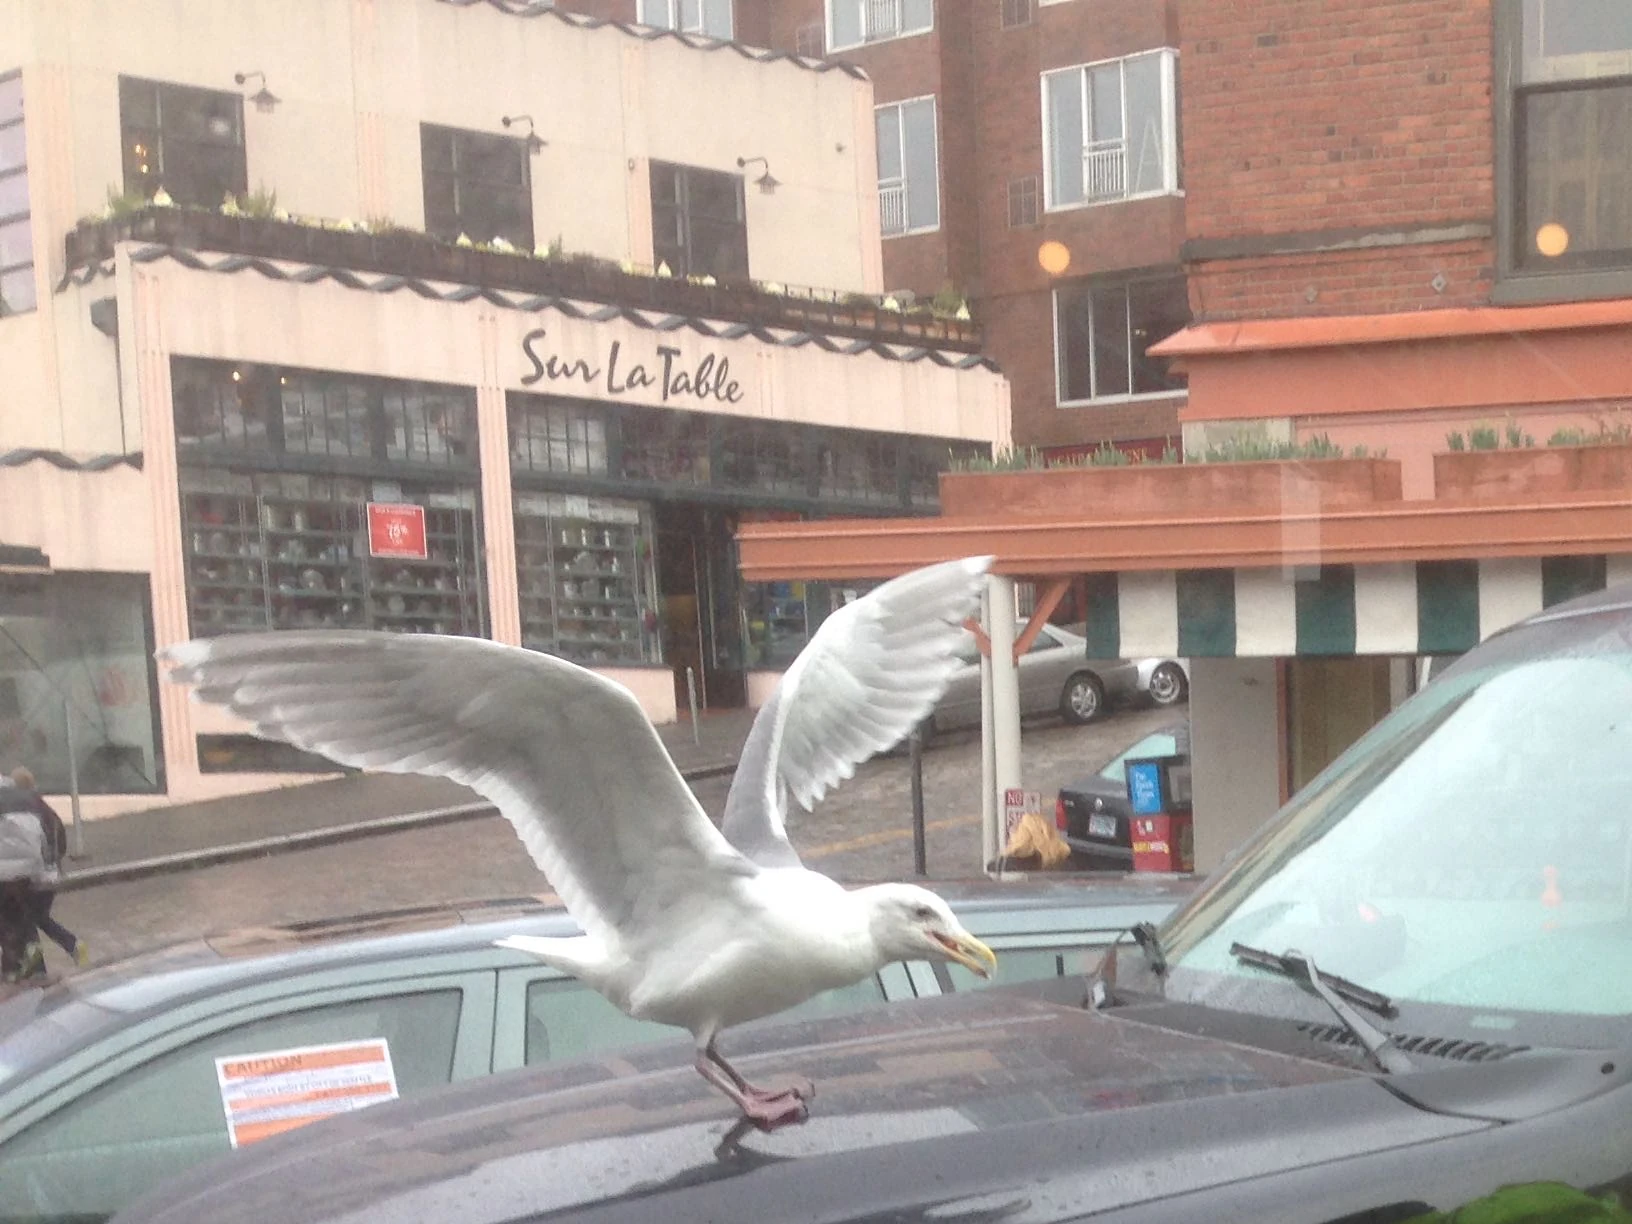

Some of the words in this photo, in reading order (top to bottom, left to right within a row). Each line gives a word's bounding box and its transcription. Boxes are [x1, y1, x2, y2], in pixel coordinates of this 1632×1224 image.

[521, 328, 600, 385] Sur
[607, 340, 655, 394] La
[657, 345, 744, 403] Table
[1007, 791, 1022, 805] NO
[223, 1055, 302, 1077] CAUTION
